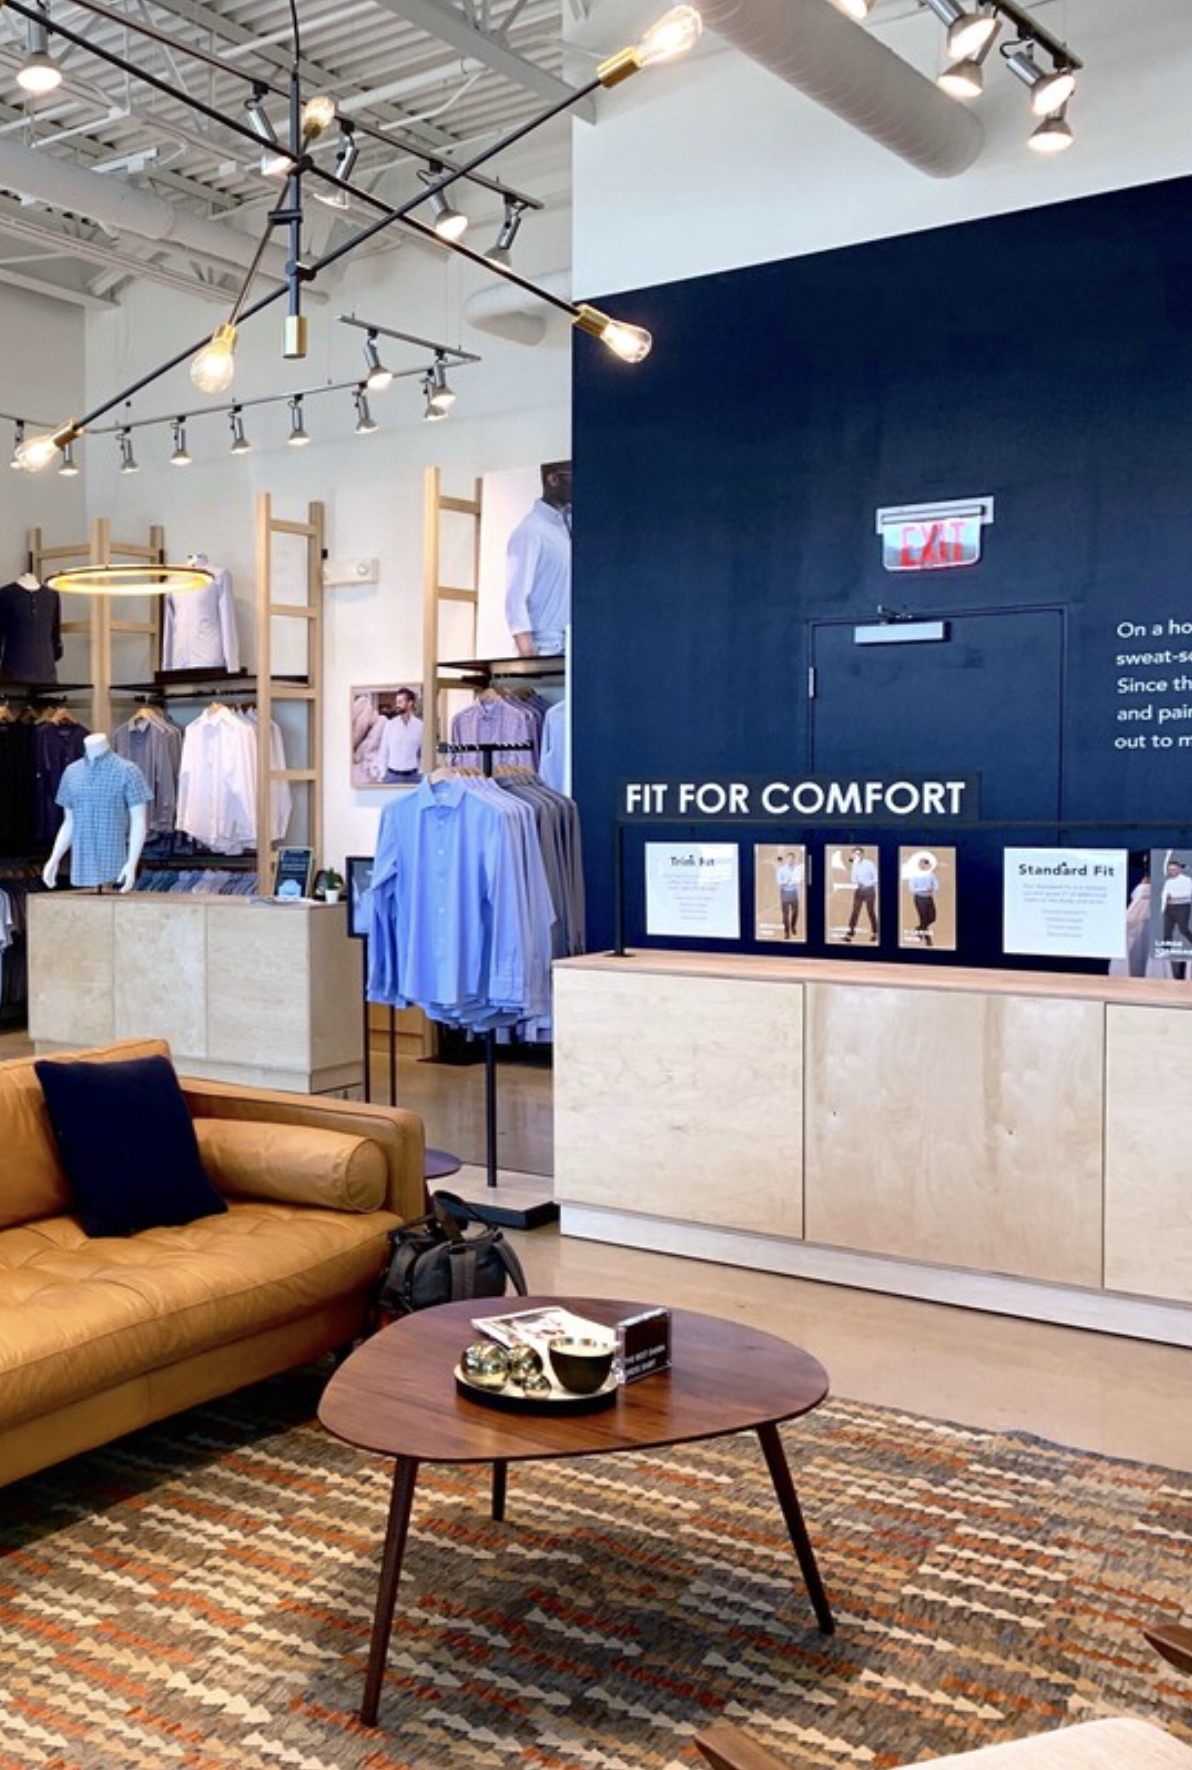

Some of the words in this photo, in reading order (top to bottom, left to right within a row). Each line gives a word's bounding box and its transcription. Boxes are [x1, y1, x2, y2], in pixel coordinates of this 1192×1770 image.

[901, 521, 966, 567] EXIT
[1116, 621, 1146, 638] On
[1152, 624, 1163, 636] a
[1117, 677, 1168, 694] Since
[1117, 704, 1153, 721] and
[1114, 735, 1146, 749] out
[1152, 735, 1172, 748] to
[626, 784, 668, 813] FIT
[679, 784, 749, 813] FOR
[762, 782, 965, 814] COMFORT
[1019, 862, 1087, 876] Standard
[1093, 865, 1115, 877] Fit
